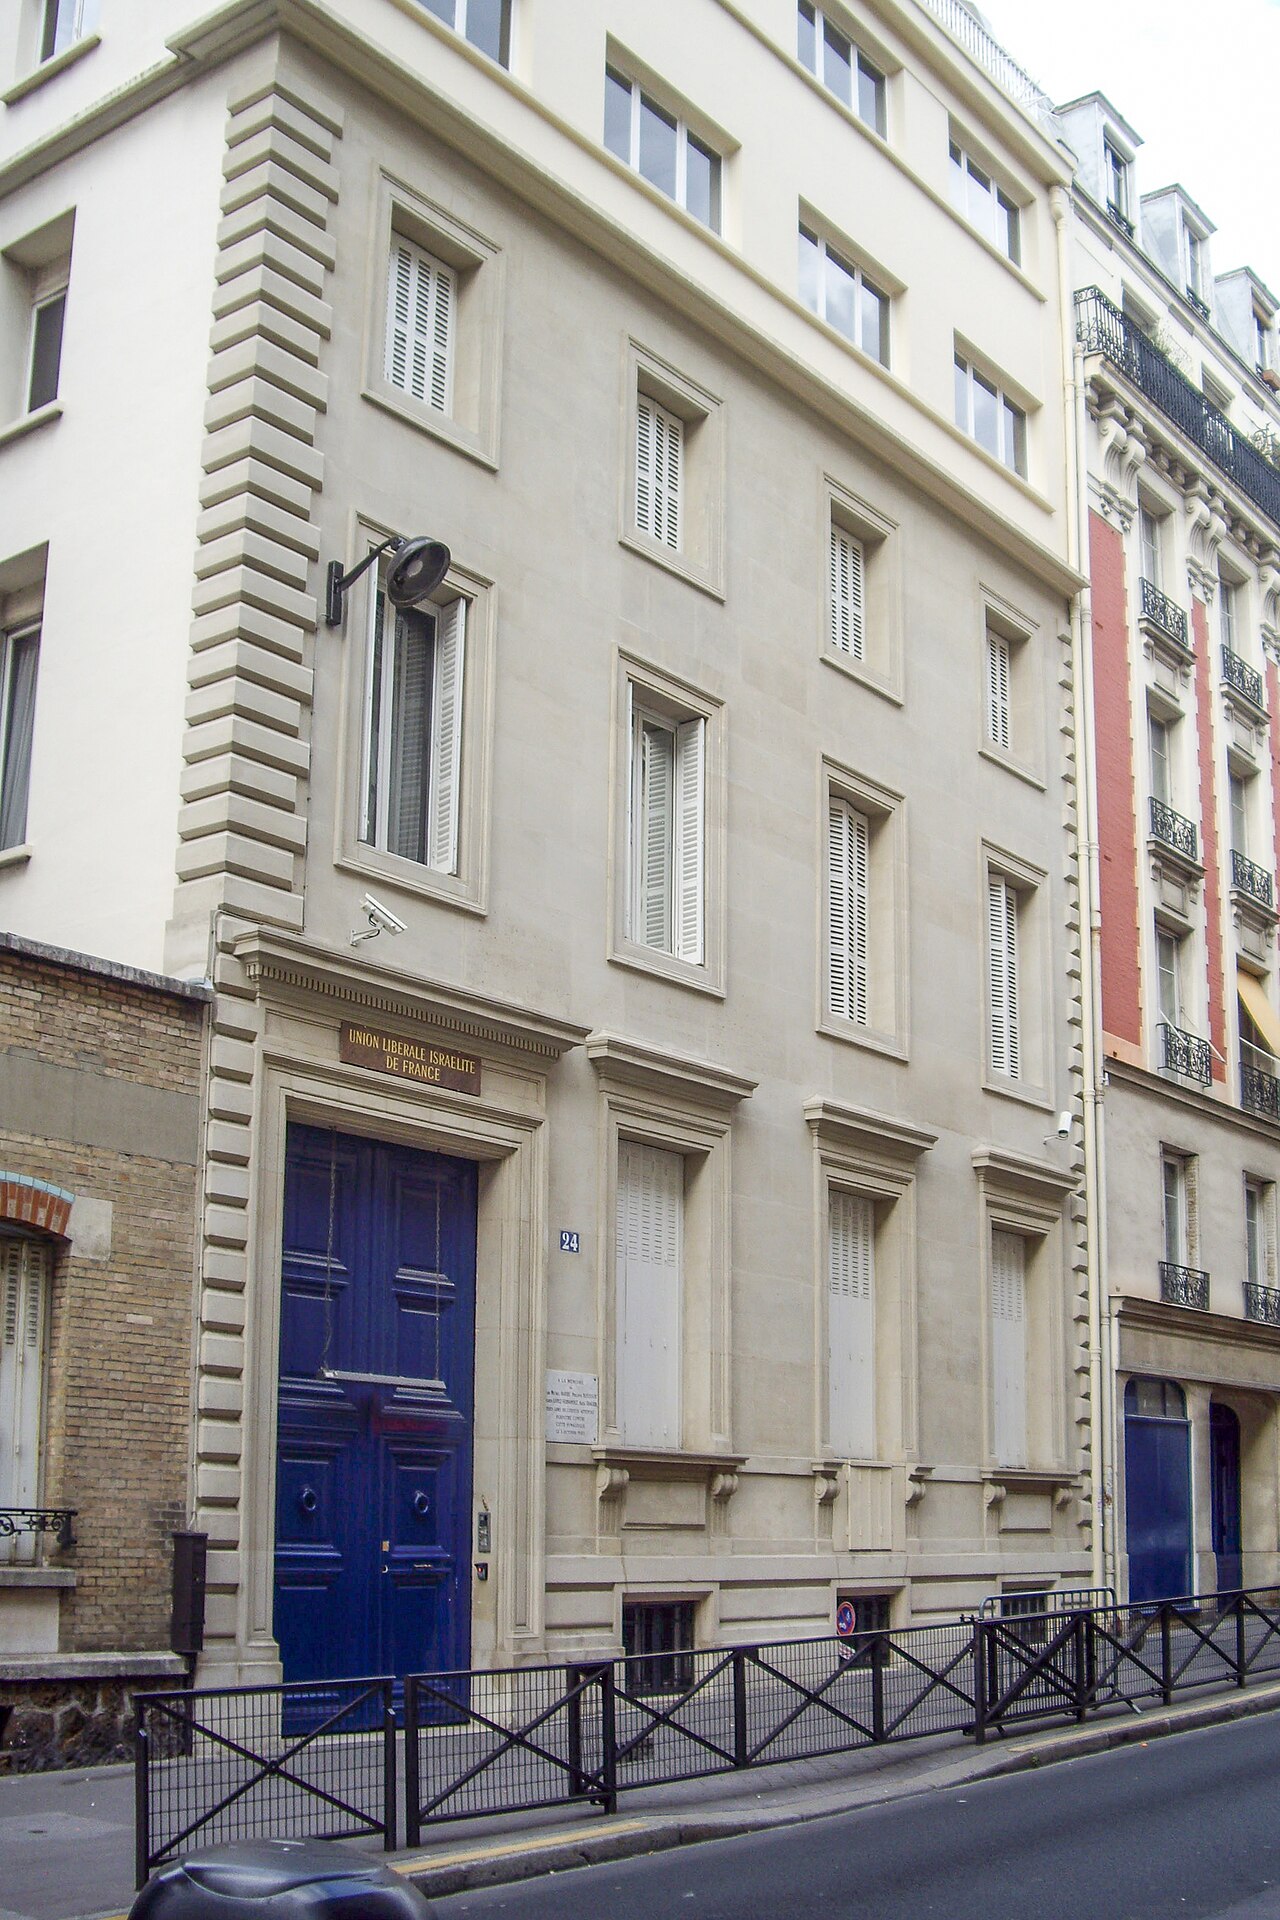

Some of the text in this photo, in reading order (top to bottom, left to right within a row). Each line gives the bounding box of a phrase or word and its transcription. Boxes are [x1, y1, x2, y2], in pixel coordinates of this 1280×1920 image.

[349, 1028, 476, 1075] UNION LIBERALE ISRAELITE
[386, 1055, 440, 1082] DE FRANCE
[562, 1232, 578, 1251] 24
